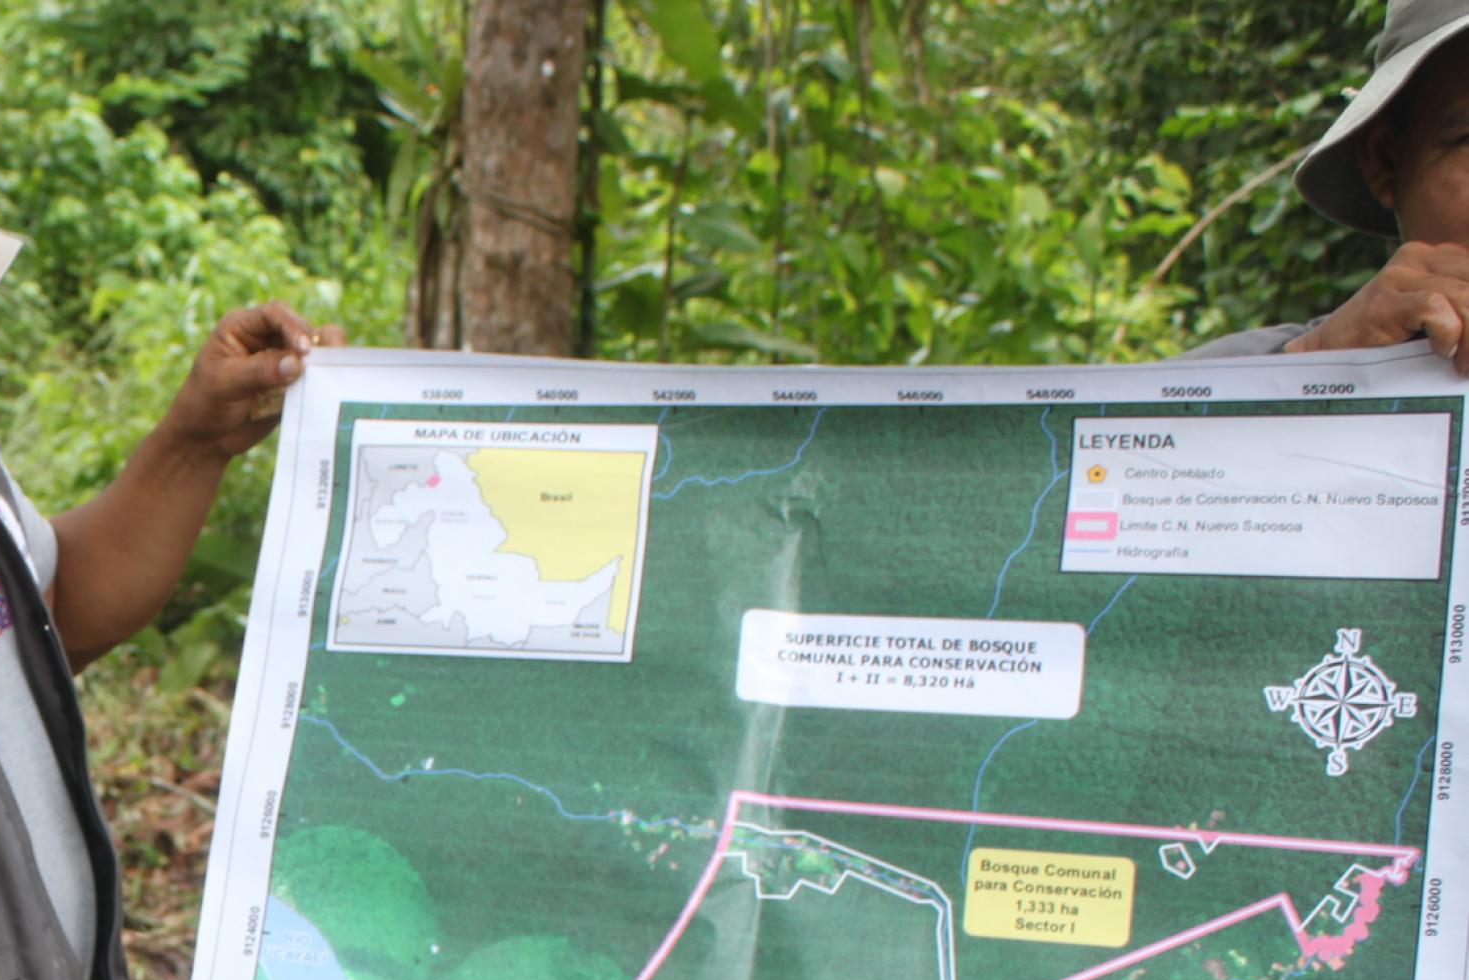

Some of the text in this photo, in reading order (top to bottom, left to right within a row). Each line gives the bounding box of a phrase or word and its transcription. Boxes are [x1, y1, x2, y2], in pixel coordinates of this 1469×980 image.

[536, 390, 579, 401] 540000
[652, 390, 697, 402] 542000
[772, 390, 818, 402] 544000
[1026, 388, 1076, 401] 548000
[1161, 385, 1212, 399] 550000
[1302, 382, 1356, 396] 552000
[414, 428, 581, 443] MAPA DE UBICACIÓN
[1079, 434, 1176, 450] LEYENDA
[1124, 466, 1226, 481] Centro poblado
[540, 491, 573, 504] Brasil
[1122, 493, 1172, 508] Bosque
[1176, 493, 1197, 506] de
[1199, 490, 1287, 506] Conservación
[1326, 492, 1372, 507] Nuevo
[1377, 493, 1439, 509] Saposoa
[1196, 520, 1239, 533] Nuevo
[1242, 520, 1304, 537] Saposoa
[1340, 631, 1359, 650] N
[1449, 604, 1467, 664] 9130000
[785, 632, 1037, 656] SUPERFICIE TOTAL DE BOSQUE
[778, 649, 1042, 674] COMUNAL PARA CONSERVACIÓN
[836, 671, 843, 684] I
[866, 673, 880, 685] II
[903, 674, 948, 689] 8,320
[954, 675, 976, 689] Há
[1267, 690, 1294, 708] W
[1398, 696, 1414, 714] E
[1331, 754, 1343, 772] S
[1437, 741, 1454, 800] 9128000
[980, 859, 1117, 881] Bosque Comunal
[974, 879, 1122, 899] para Conservación
[1016, 900, 1079, 916] 1,333 ha
[1425, 877, 1442, 937] 9126000
[243, 906, 260, 956] 9124000
[1015, 918, 1066, 933] Sector
